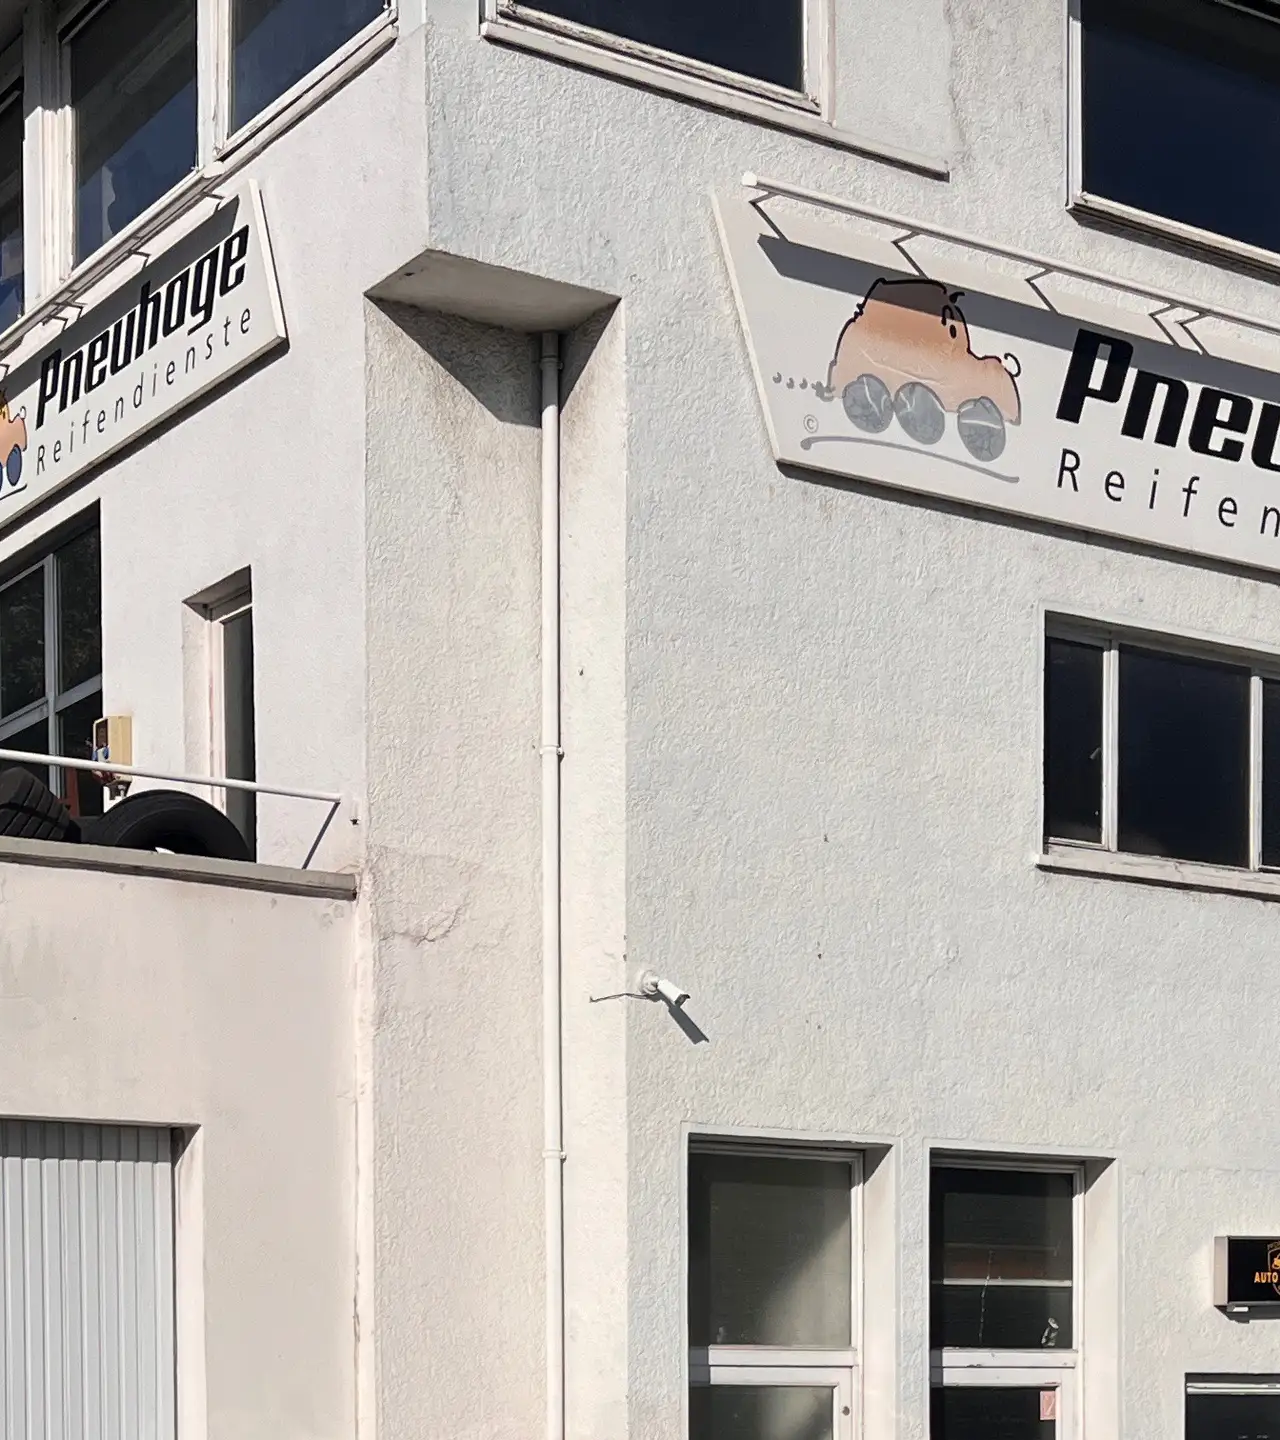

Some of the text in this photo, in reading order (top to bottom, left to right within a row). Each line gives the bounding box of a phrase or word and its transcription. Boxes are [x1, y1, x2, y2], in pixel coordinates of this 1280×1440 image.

[36, 225, 249, 430] Pneuhage
[37, 308, 251, 476] Reifendienste
[1254, 1272, 1278, 1283] AUTO
